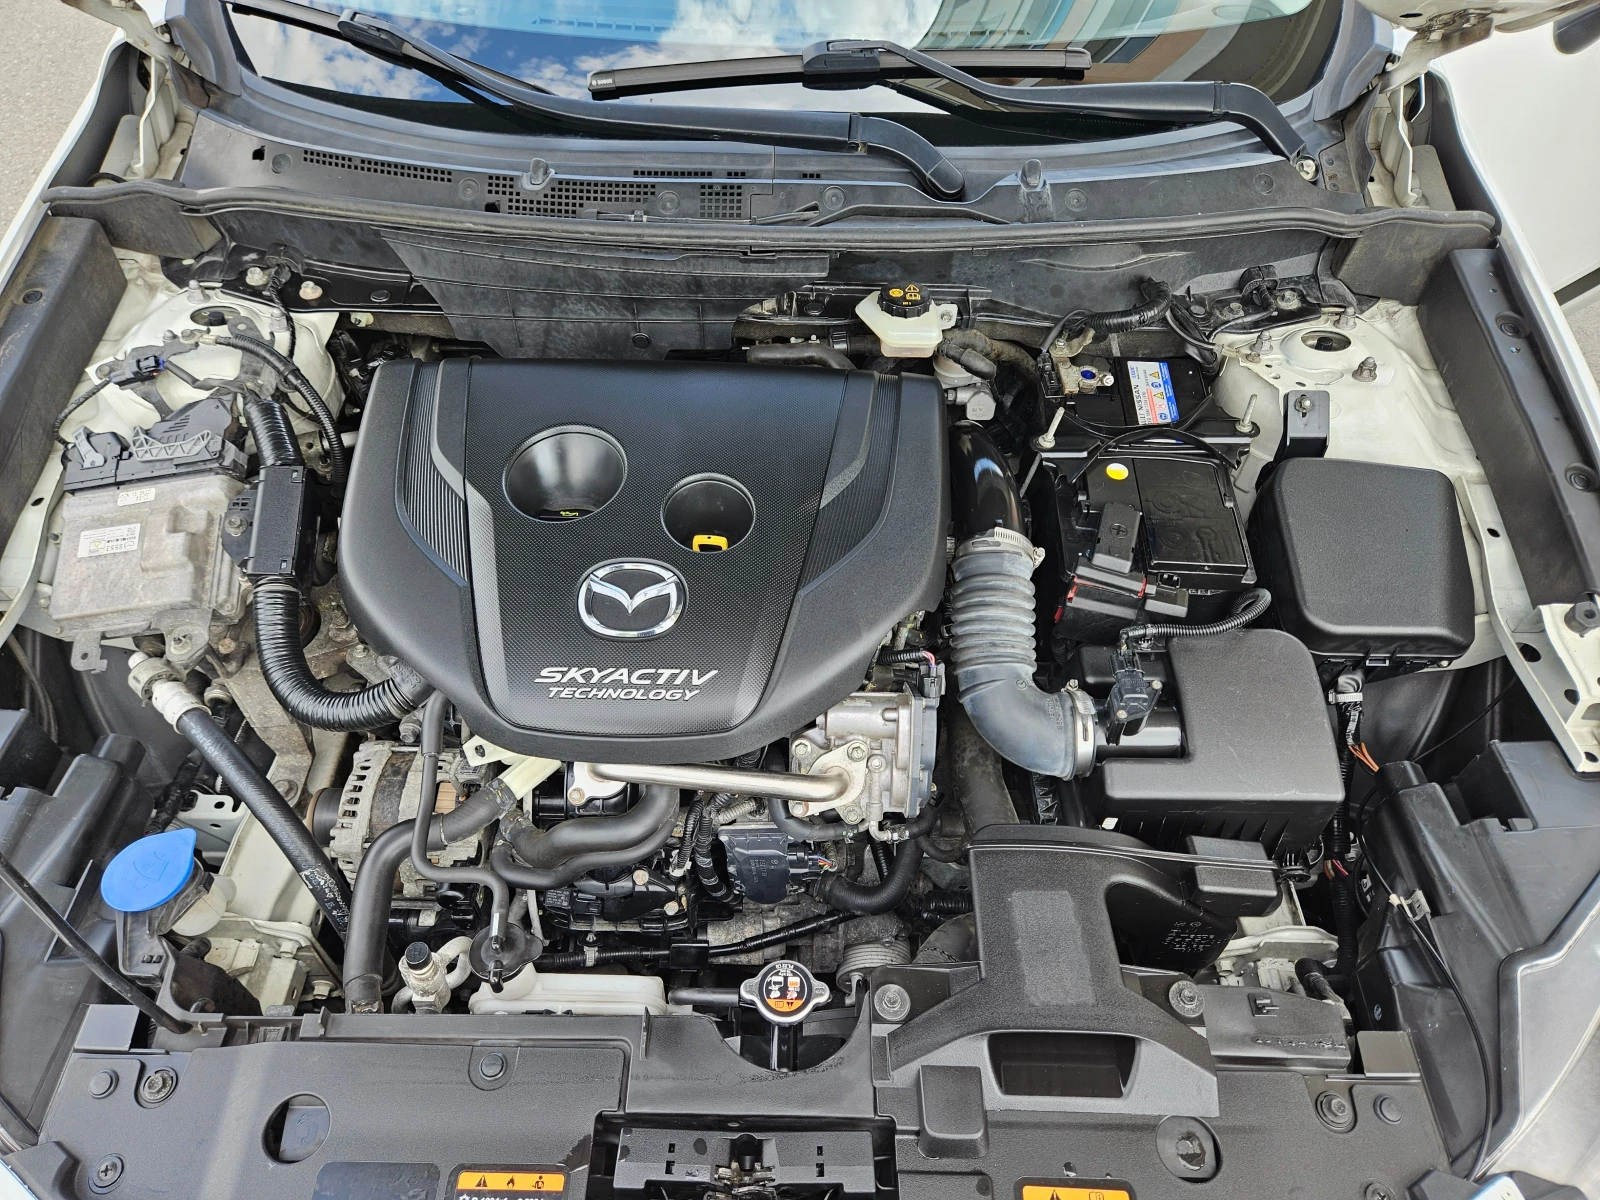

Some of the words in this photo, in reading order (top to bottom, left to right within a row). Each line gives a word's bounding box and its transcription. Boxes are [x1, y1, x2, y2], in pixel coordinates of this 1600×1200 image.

[1133, 384, 1144, 411] NISSAN
[534, 667, 718, 686] SKYACTIV
[548, 687, 700, 701] TECHNOLOGY
